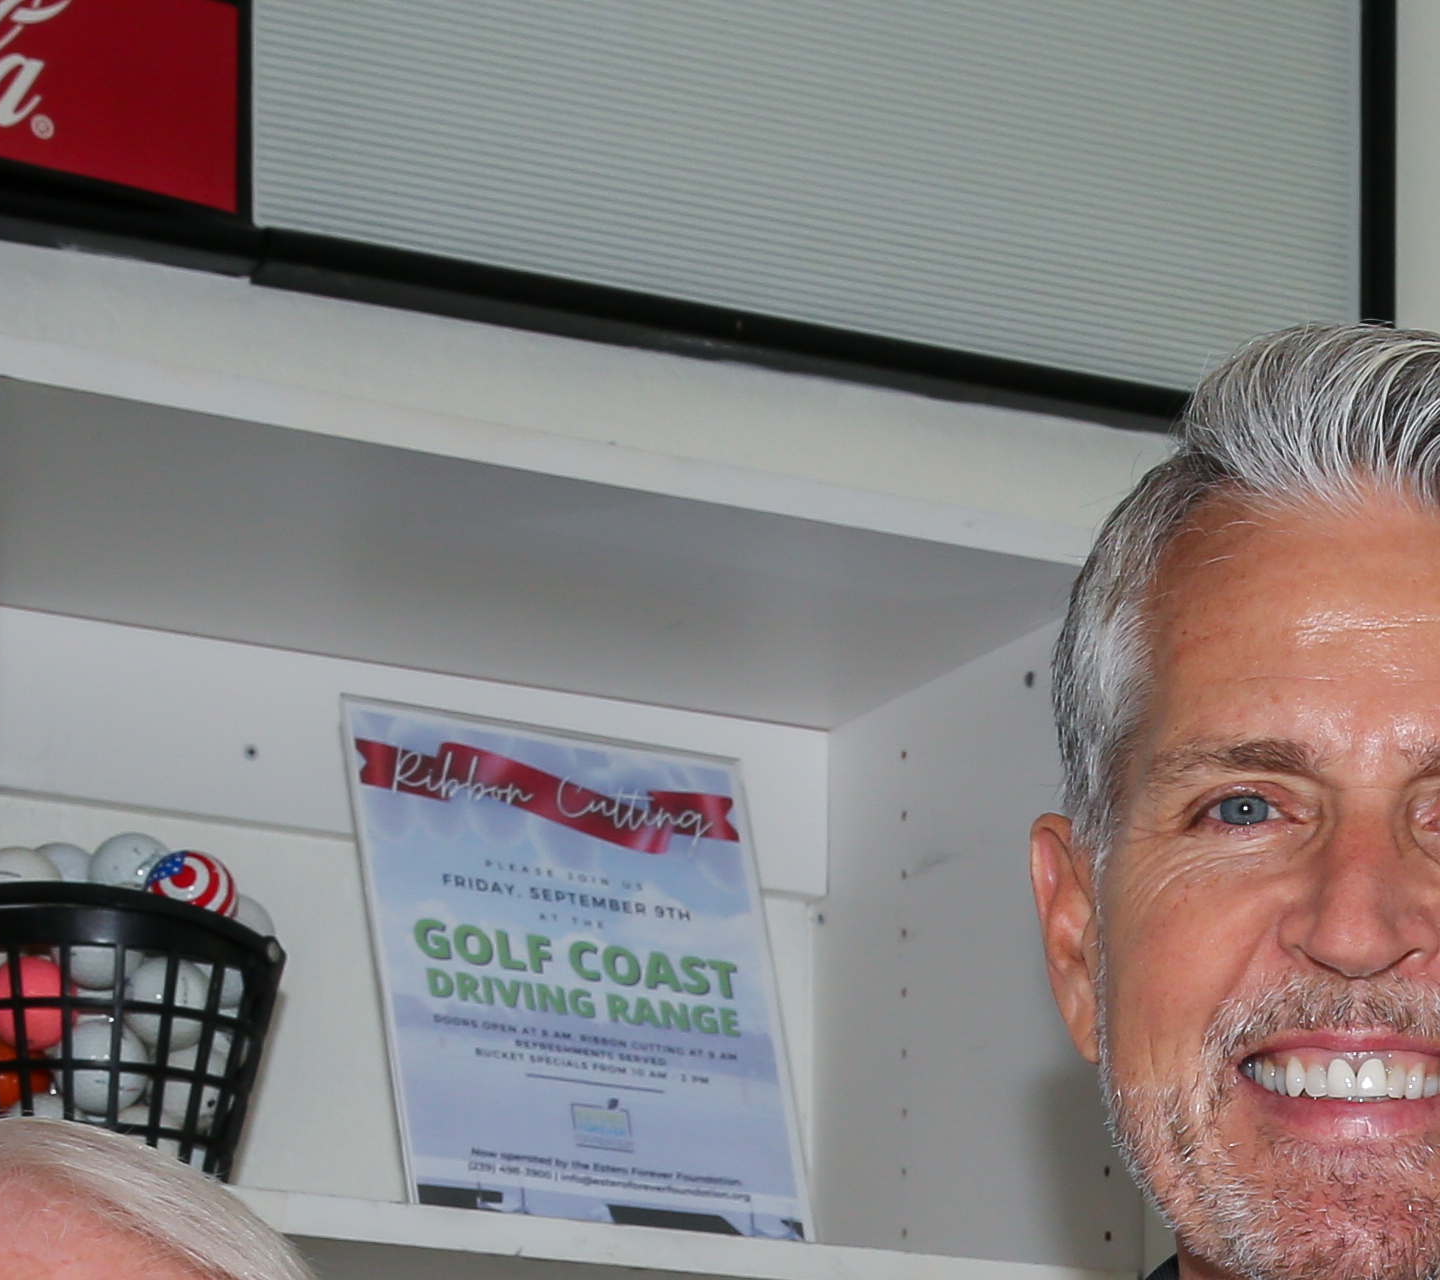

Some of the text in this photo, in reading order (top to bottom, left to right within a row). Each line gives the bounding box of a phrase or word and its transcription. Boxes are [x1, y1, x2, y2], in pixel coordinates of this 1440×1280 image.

[391, 747, 713, 858] Ribbon Cutting
[484, 859, 644, 892] PLEASE JOIN US
[529, 887, 647, 916] SEPTEMBER
[654, 905, 692, 922] 9TH
[538, 912, 605, 930] AT THE
[413, 918, 738, 999] GOLF COAST
[426, 967, 742, 1037] DRIVING RANGE
[433, 1014, 478, 1030] DOORS
[482, 1020, 518, 1035] OPEN
[522, 1025, 538, 1037] AT
[579, 1033, 628, 1050] RIBBON
[631, 1039, 686, 1057] CUTTING
[689, 1046, 707, 1059] AT
[474, 1047, 526, 1063] BUCKET
[528, 1053, 589, 1072] SPECIALS
[592, 1060, 627, 1076] FROM
[570, 1158, 590, 1172] the
